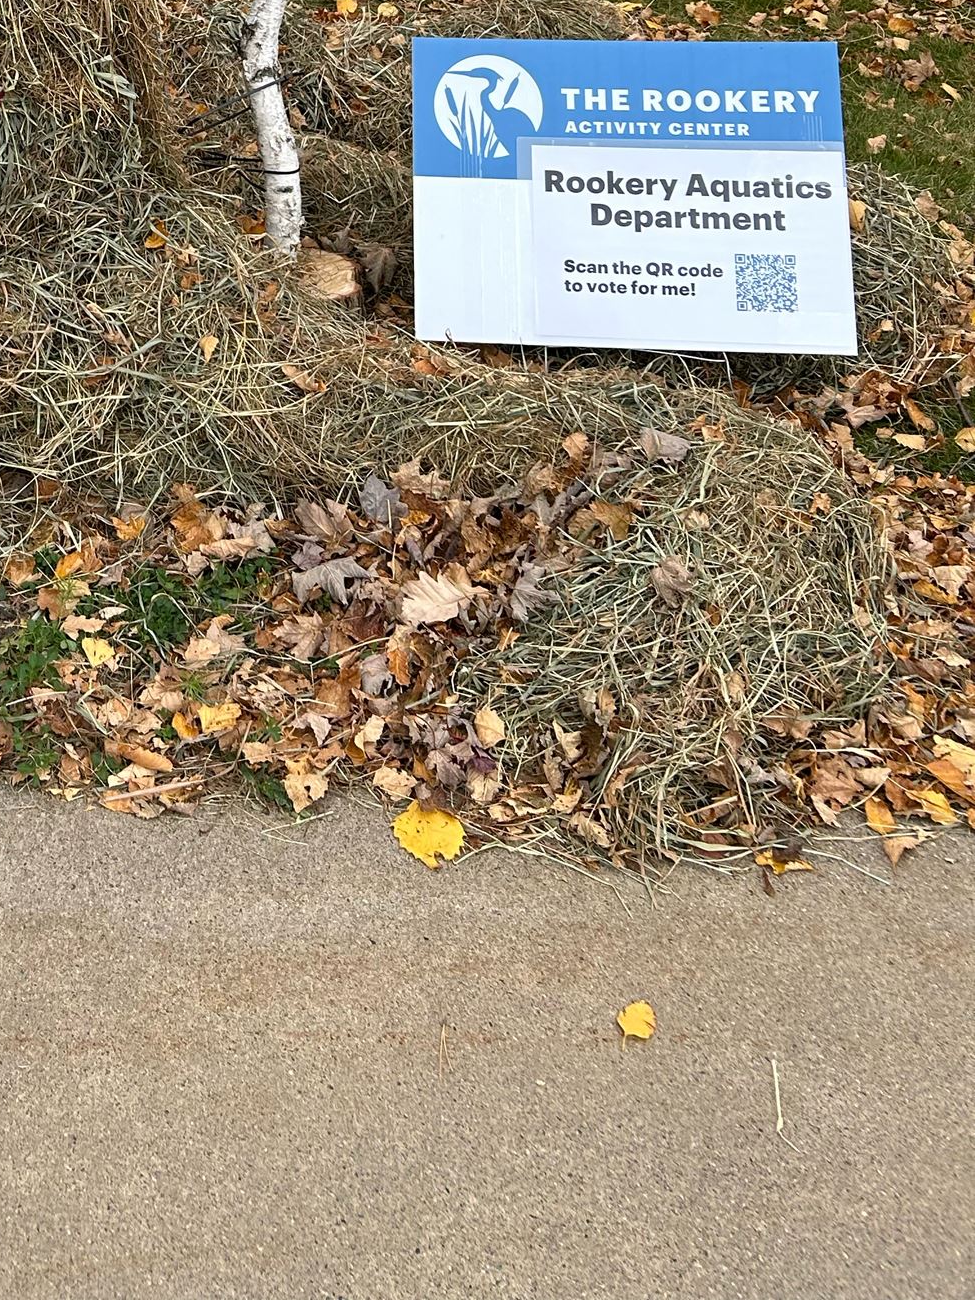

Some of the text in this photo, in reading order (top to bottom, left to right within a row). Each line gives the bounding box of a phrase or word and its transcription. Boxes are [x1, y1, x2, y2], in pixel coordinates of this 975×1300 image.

[560, 88, 820, 113] THE ROOKERY
[564, 120, 750, 136] ACTIVITY CENTER
[544, 170, 832, 202] Rookery Aquatics
[590, 203, 786, 232] Department
[564, 259, 724, 278] Scan the QR code
[564, 279, 696, 297] to vote for me!
